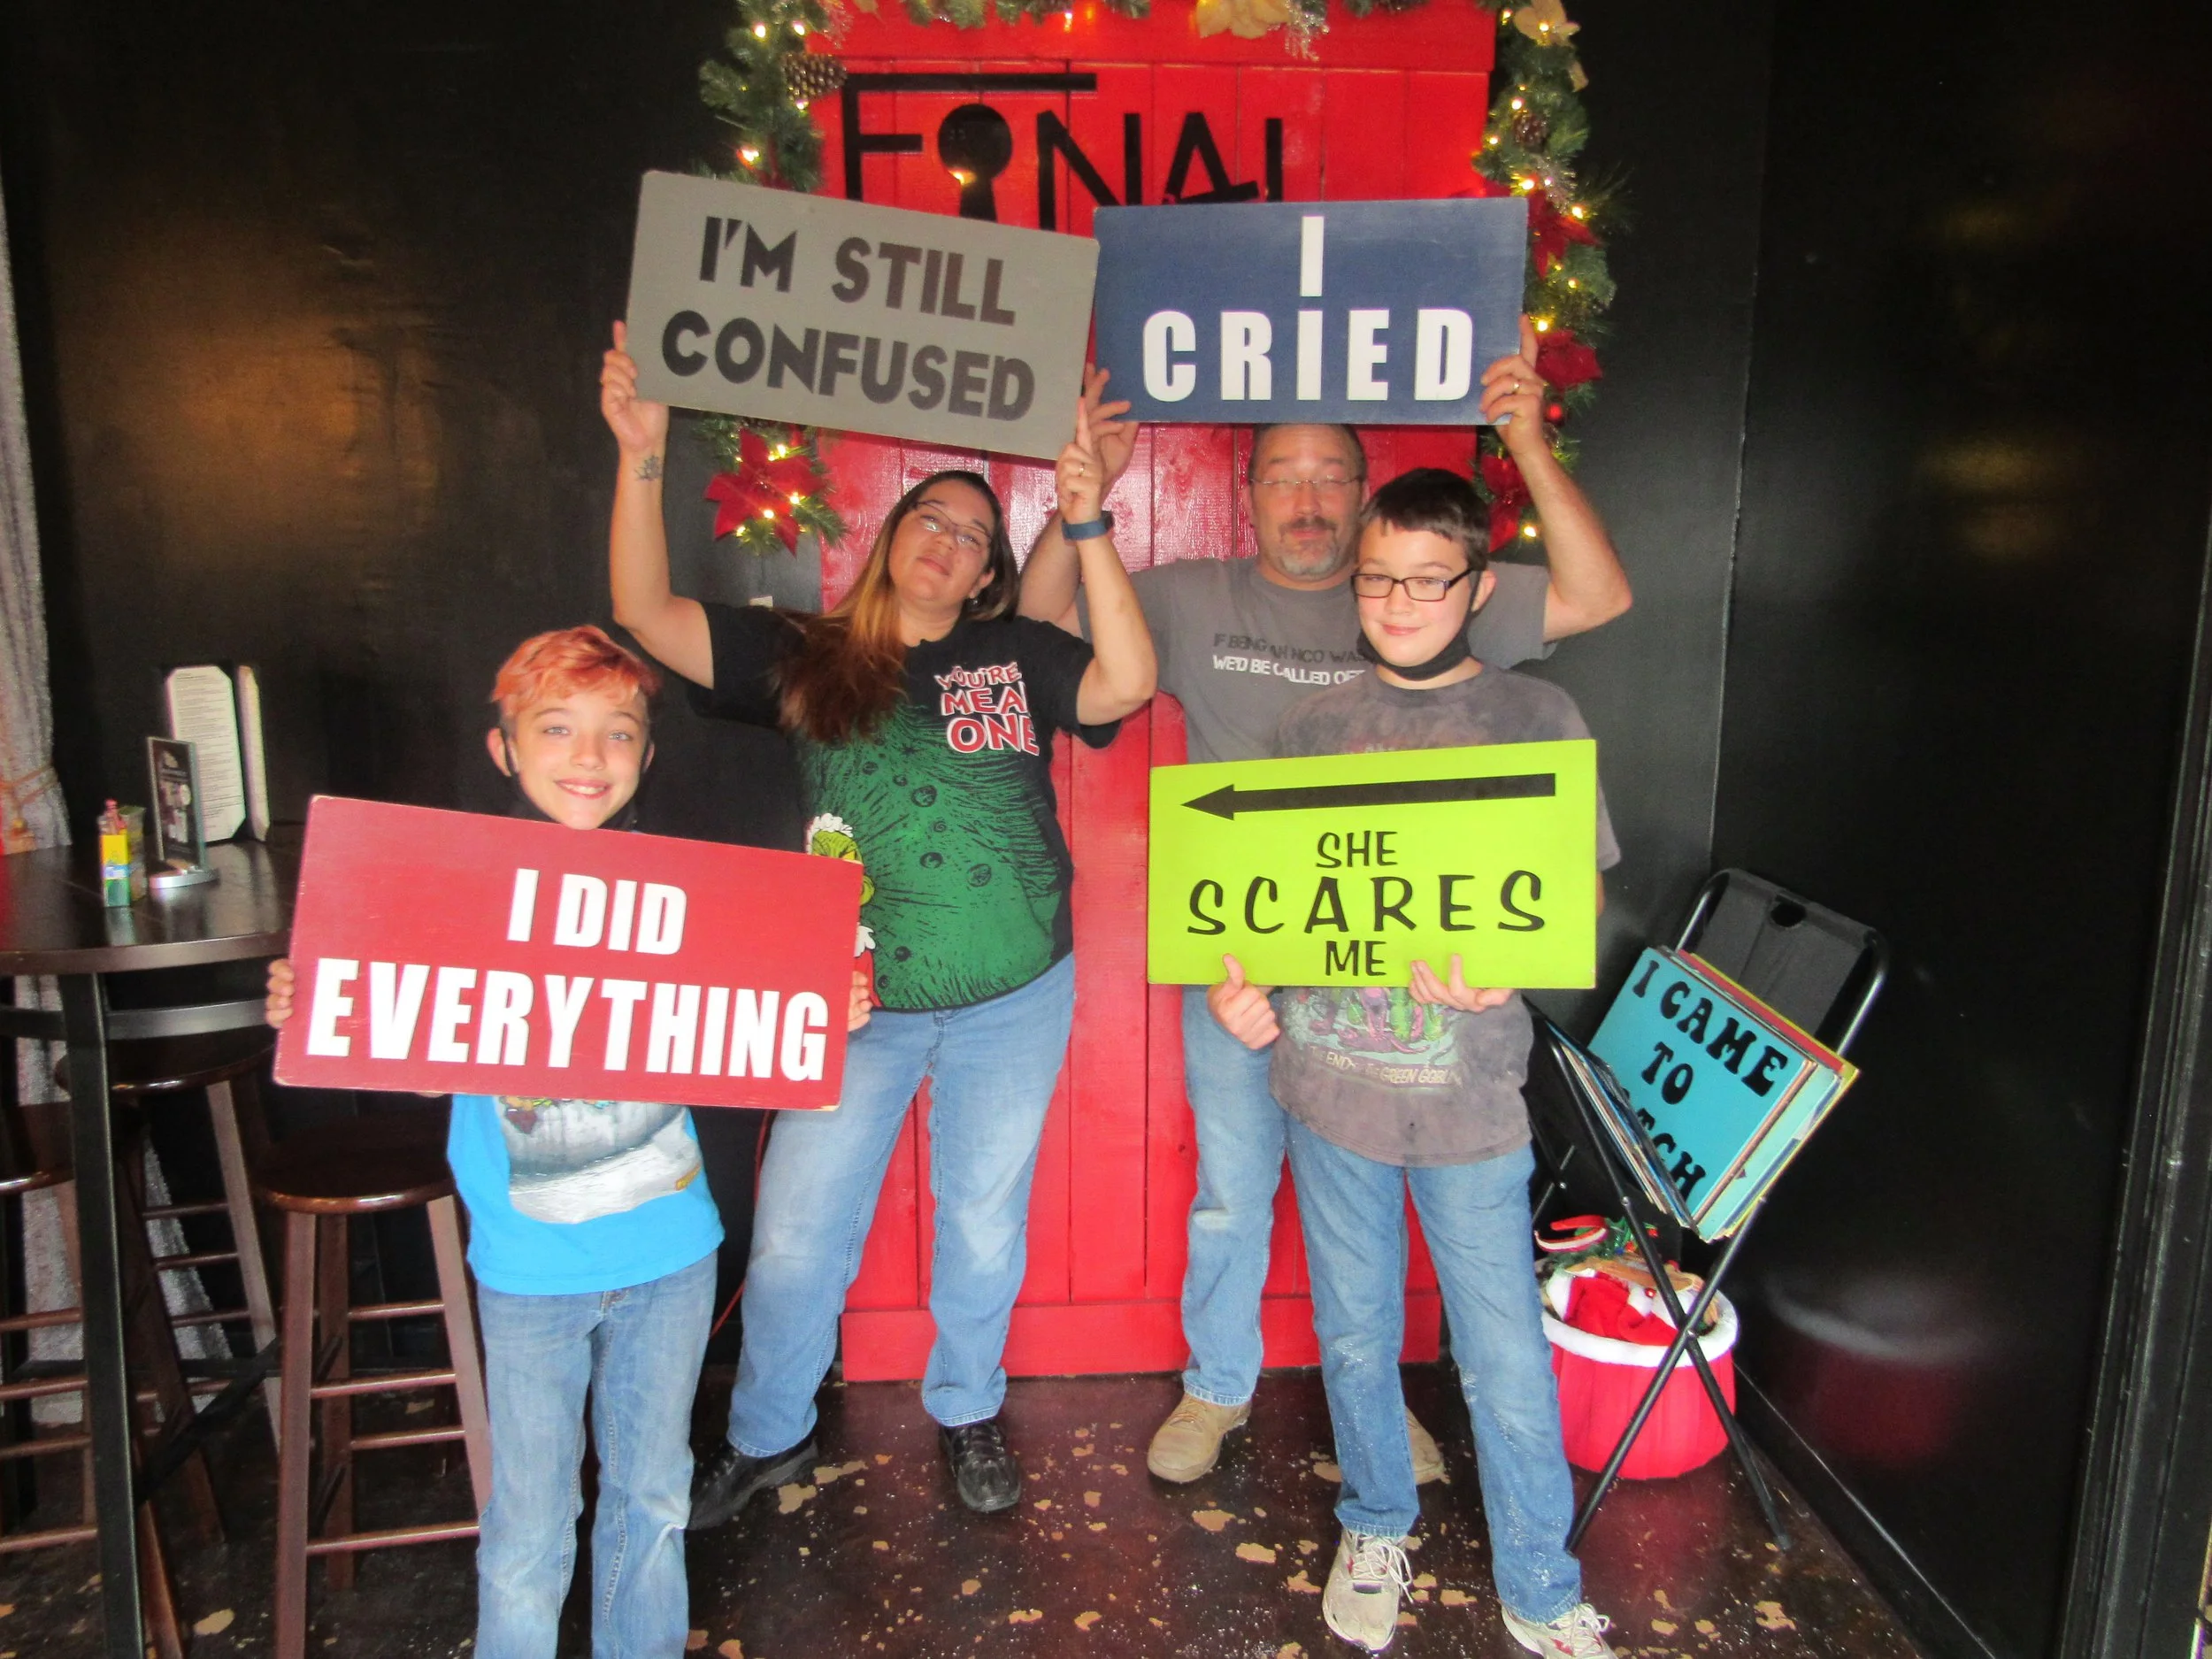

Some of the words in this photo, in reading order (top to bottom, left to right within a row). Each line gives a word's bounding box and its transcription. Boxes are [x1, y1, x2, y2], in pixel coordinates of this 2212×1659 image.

[700, 215, 798, 293] I'M
[832, 237, 1016, 326] STILL
[1299, 216, 1325, 297] I
[661, 311, 1035, 421] CONFUSED
[1143, 310, 1473, 402] CRIED
[941, 680, 1032, 716] MEA
[1249, 658, 1271, 676] BE
[1272, 663, 1331, 687] CALLED
[946, 712, 1041, 757] ONE
[1316, 830, 1398, 869] SHE
[507, 868, 540, 942] I
[553, 873, 687, 956] DID
[1187, 870, 1546, 936] SCARES
[1325, 940, 1387, 977] ME
[306, 957, 830, 1082] EVERYTHING
[1632, 959, 1660, 998] I
[1660, 980, 1788, 1097] CAME
[1640, 1041, 1694, 1105] TO
